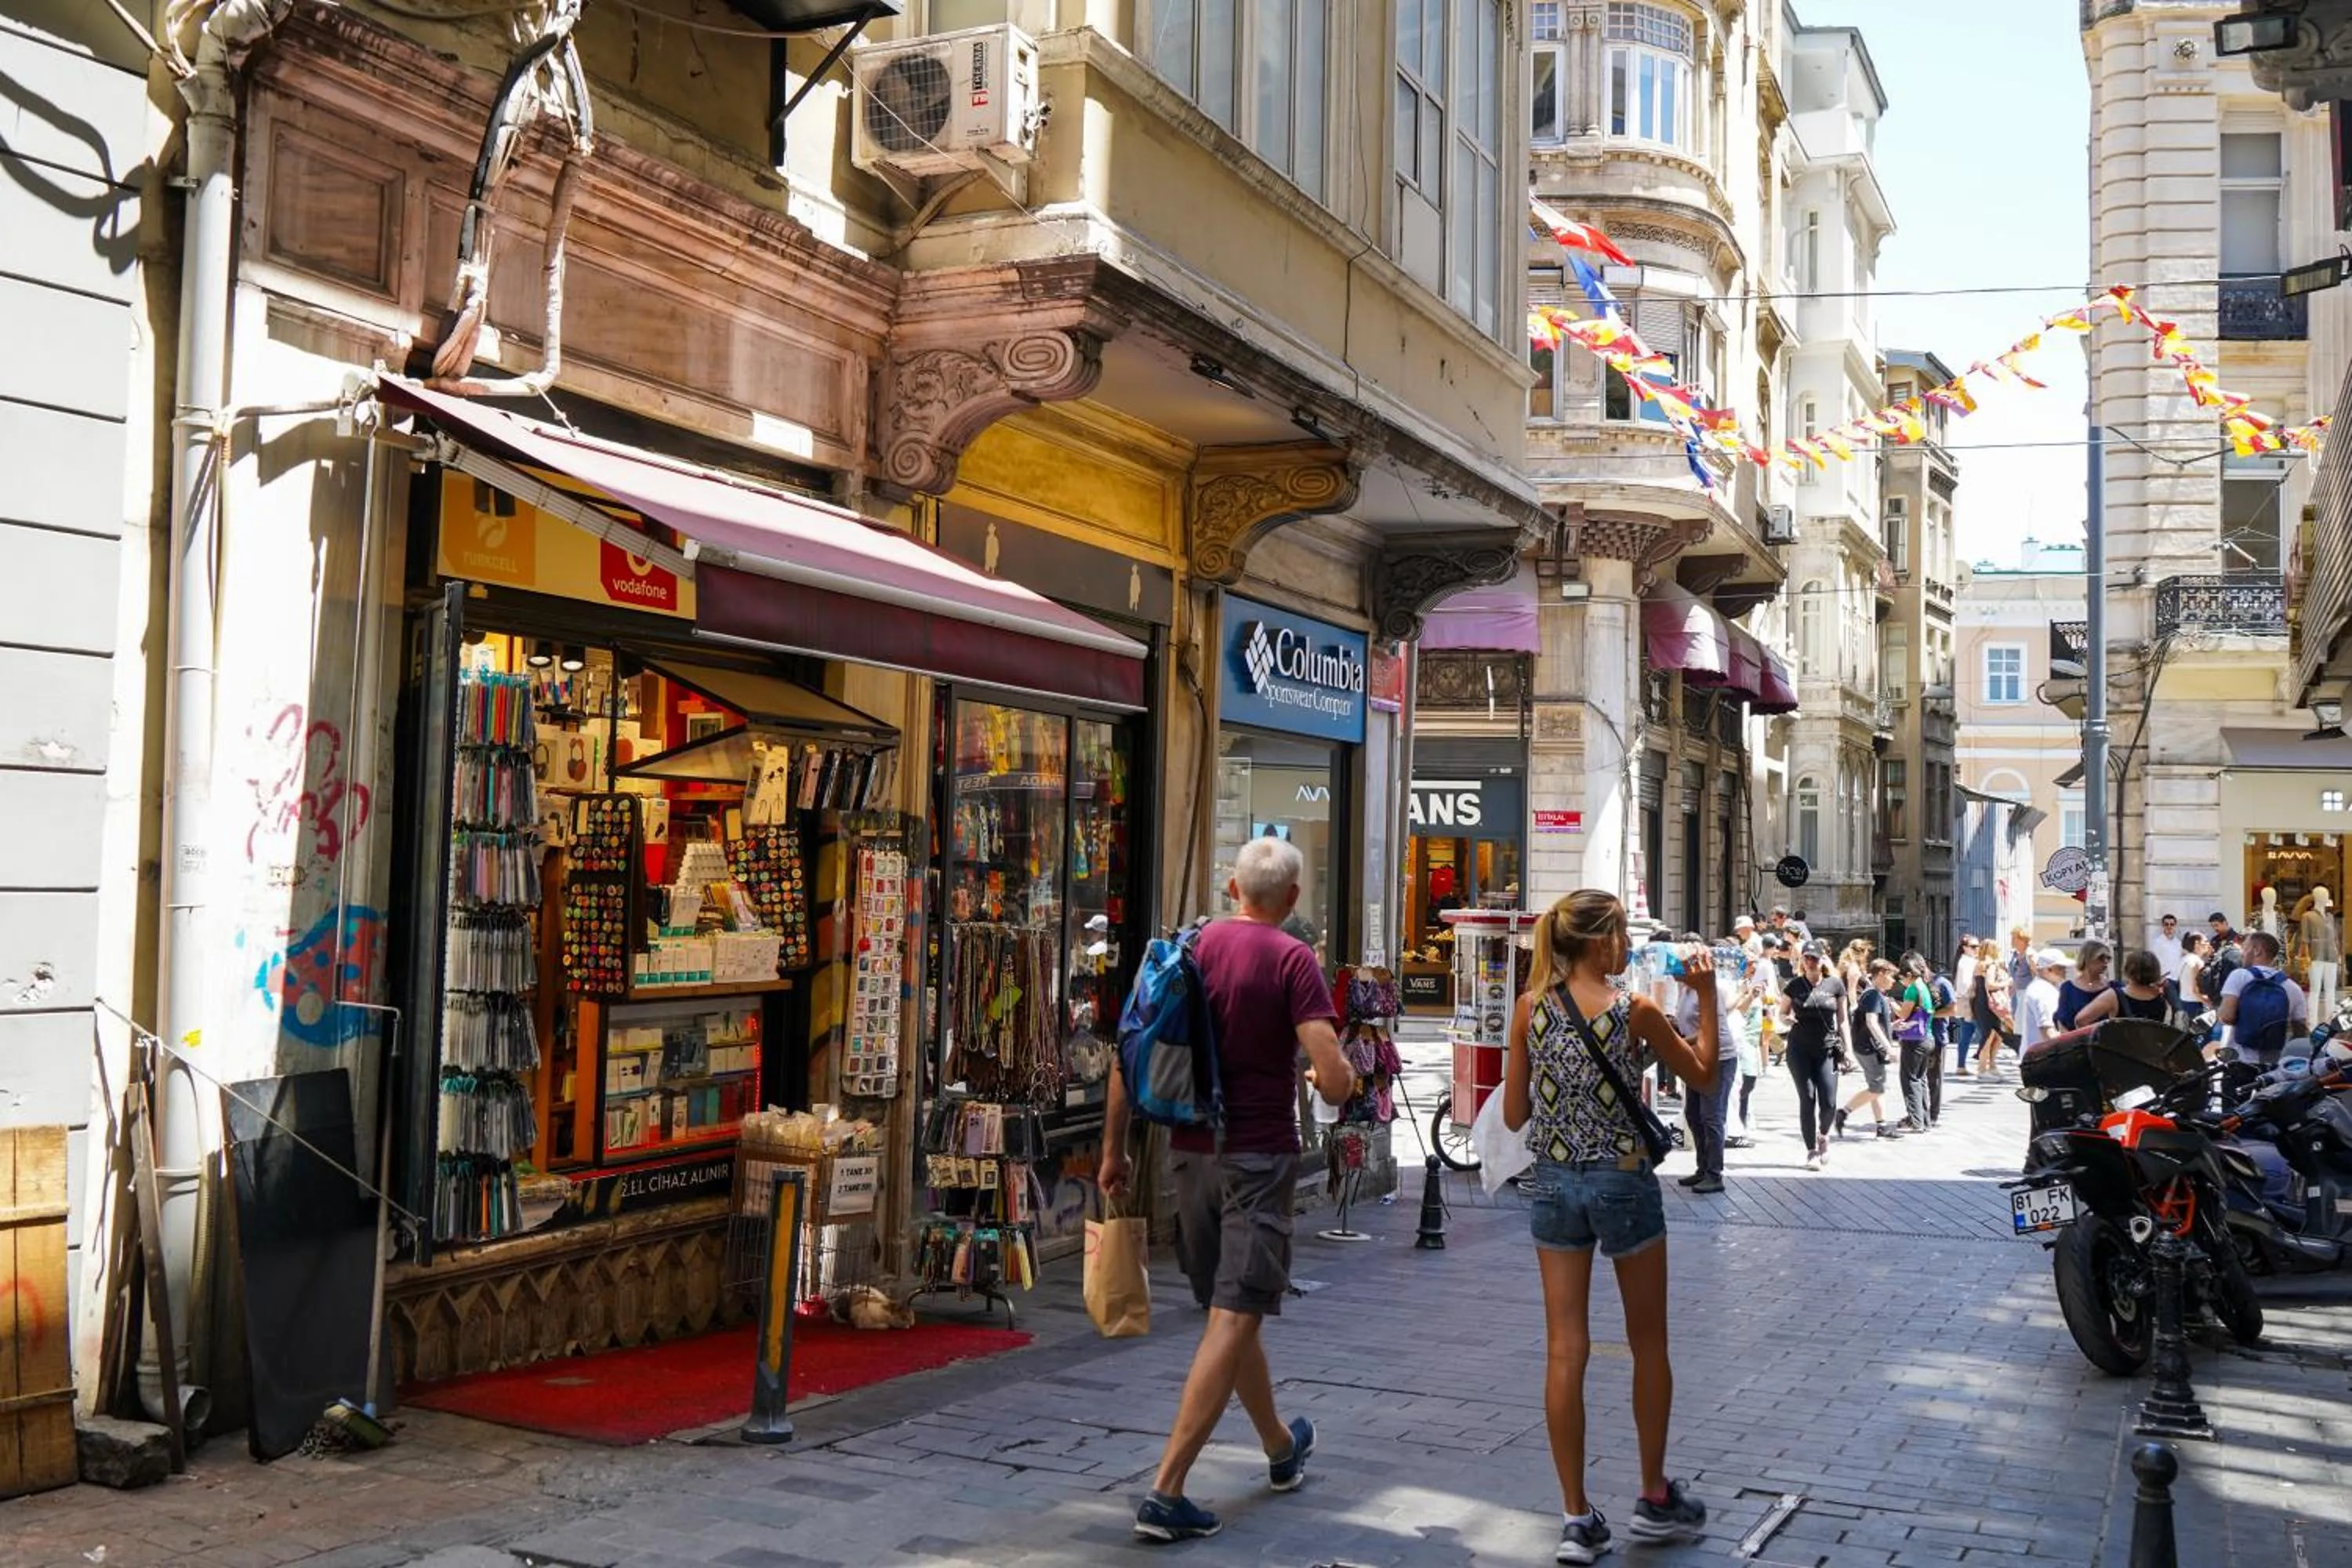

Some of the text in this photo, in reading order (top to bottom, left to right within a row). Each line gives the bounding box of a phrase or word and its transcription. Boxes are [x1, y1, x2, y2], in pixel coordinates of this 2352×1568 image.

[612, 578, 667, 600] vodafone
[1276, 628, 1364, 693] Columbia
[1265, 679, 1313, 708] Sportswear
[1409, 792, 1482, 826] ANS
[1409, 978, 1436, 989] VANS
[648, 1171, 688, 1192] CİHAZ
[690, 1163, 729, 1185] ALINIR
[2016, 1186, 2070, 1210] 81 FK
[2031, 1206, 2061, 1224] 022
